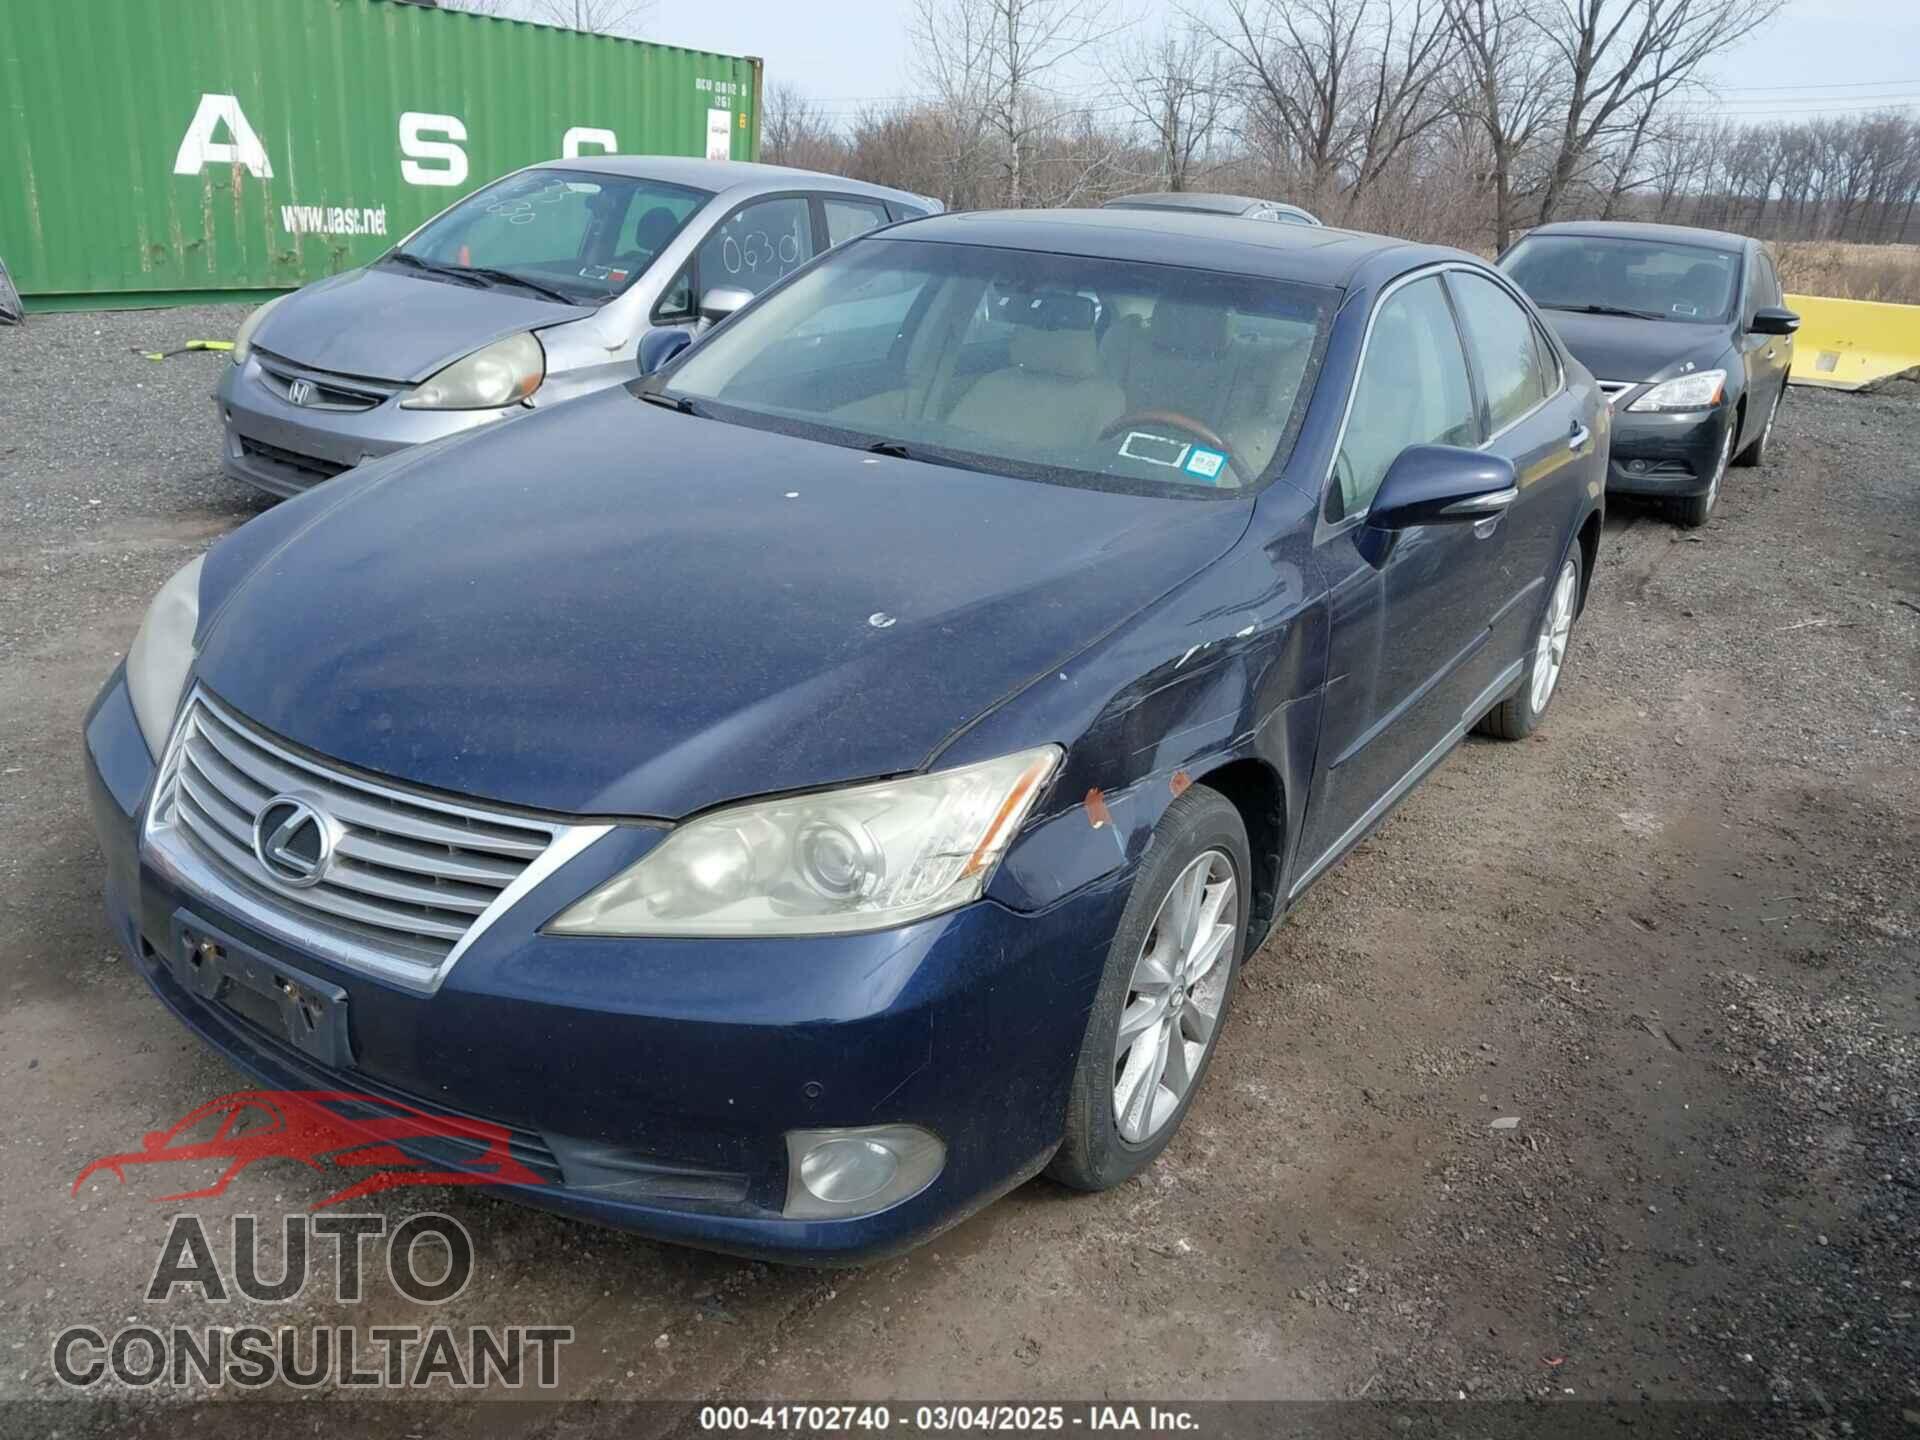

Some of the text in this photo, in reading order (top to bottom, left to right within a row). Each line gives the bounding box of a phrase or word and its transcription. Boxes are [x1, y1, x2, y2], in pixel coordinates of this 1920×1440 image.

[174, 93, 274, 178] A
[399, 112, 469, 186] S
[281, 203, 387, 235] www.uasc.net
